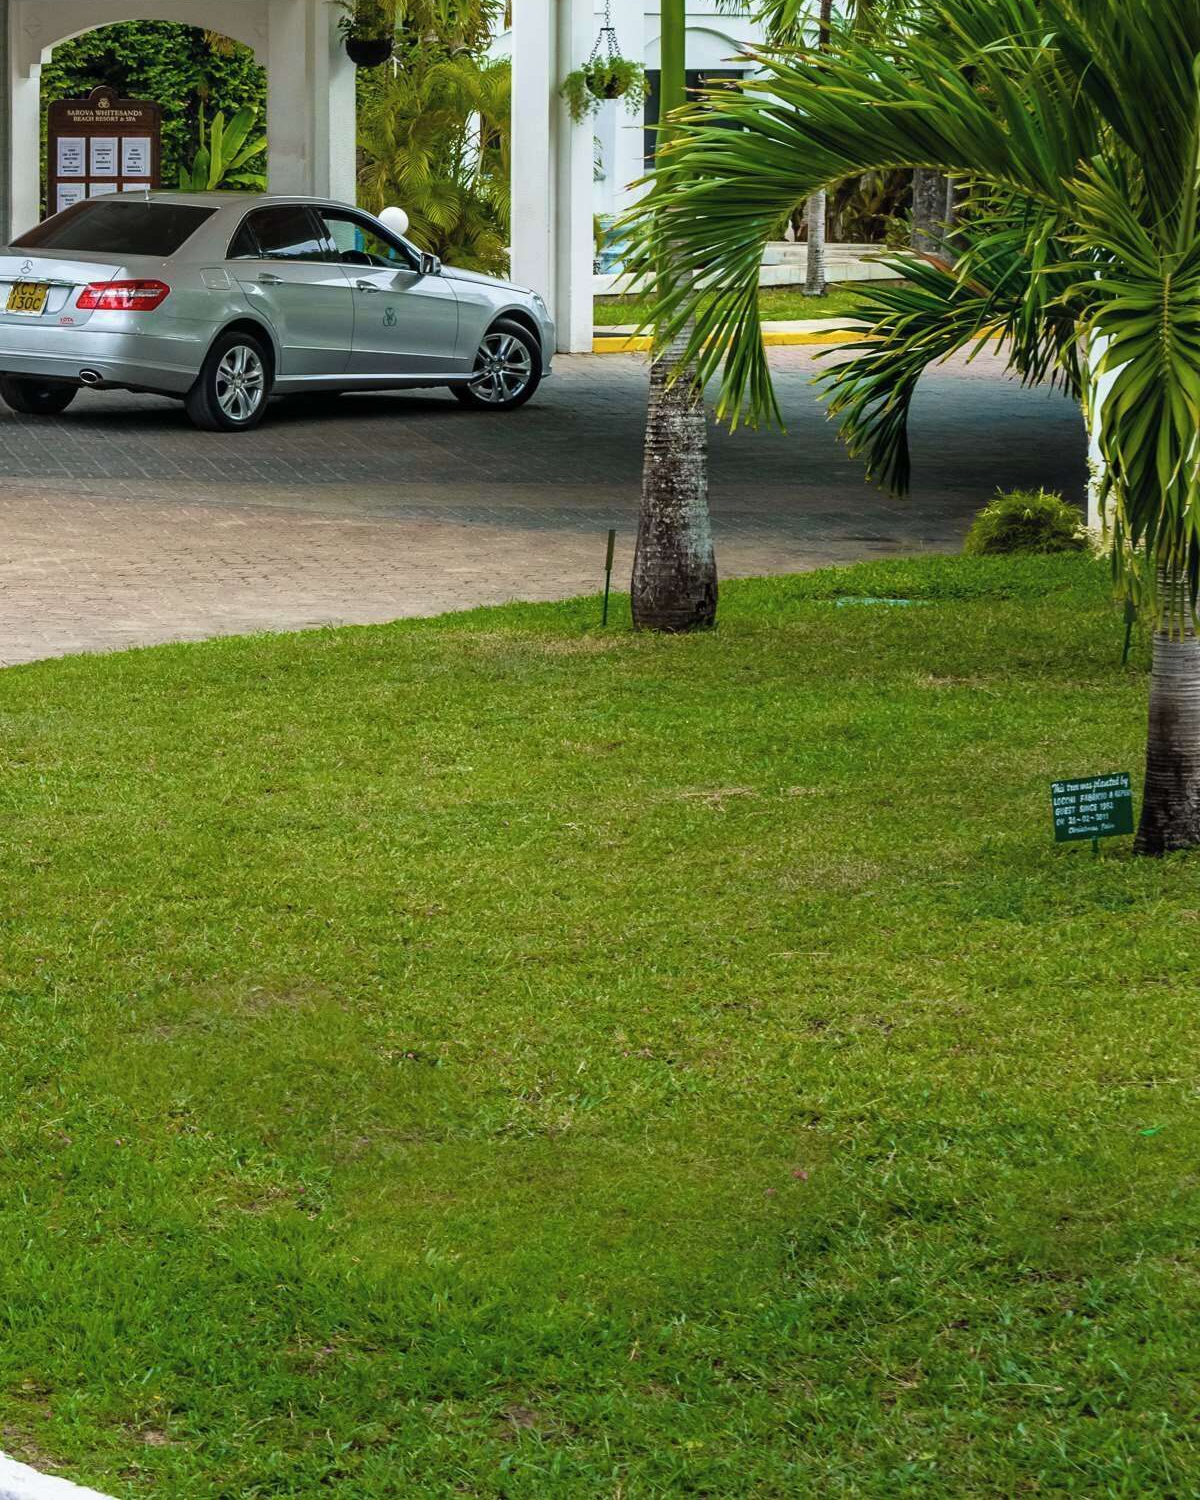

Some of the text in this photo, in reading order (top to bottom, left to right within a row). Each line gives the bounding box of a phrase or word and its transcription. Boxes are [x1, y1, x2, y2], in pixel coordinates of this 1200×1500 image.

[66, 109, 143, 117] SAROVA WHITESANDS
[10, 297, 41, 310] 130C
[1120, 775, 1128, 788] by
[1055, 806, 1076, 816] GUEST
[1079, 803, 1098, 813] SINCE
